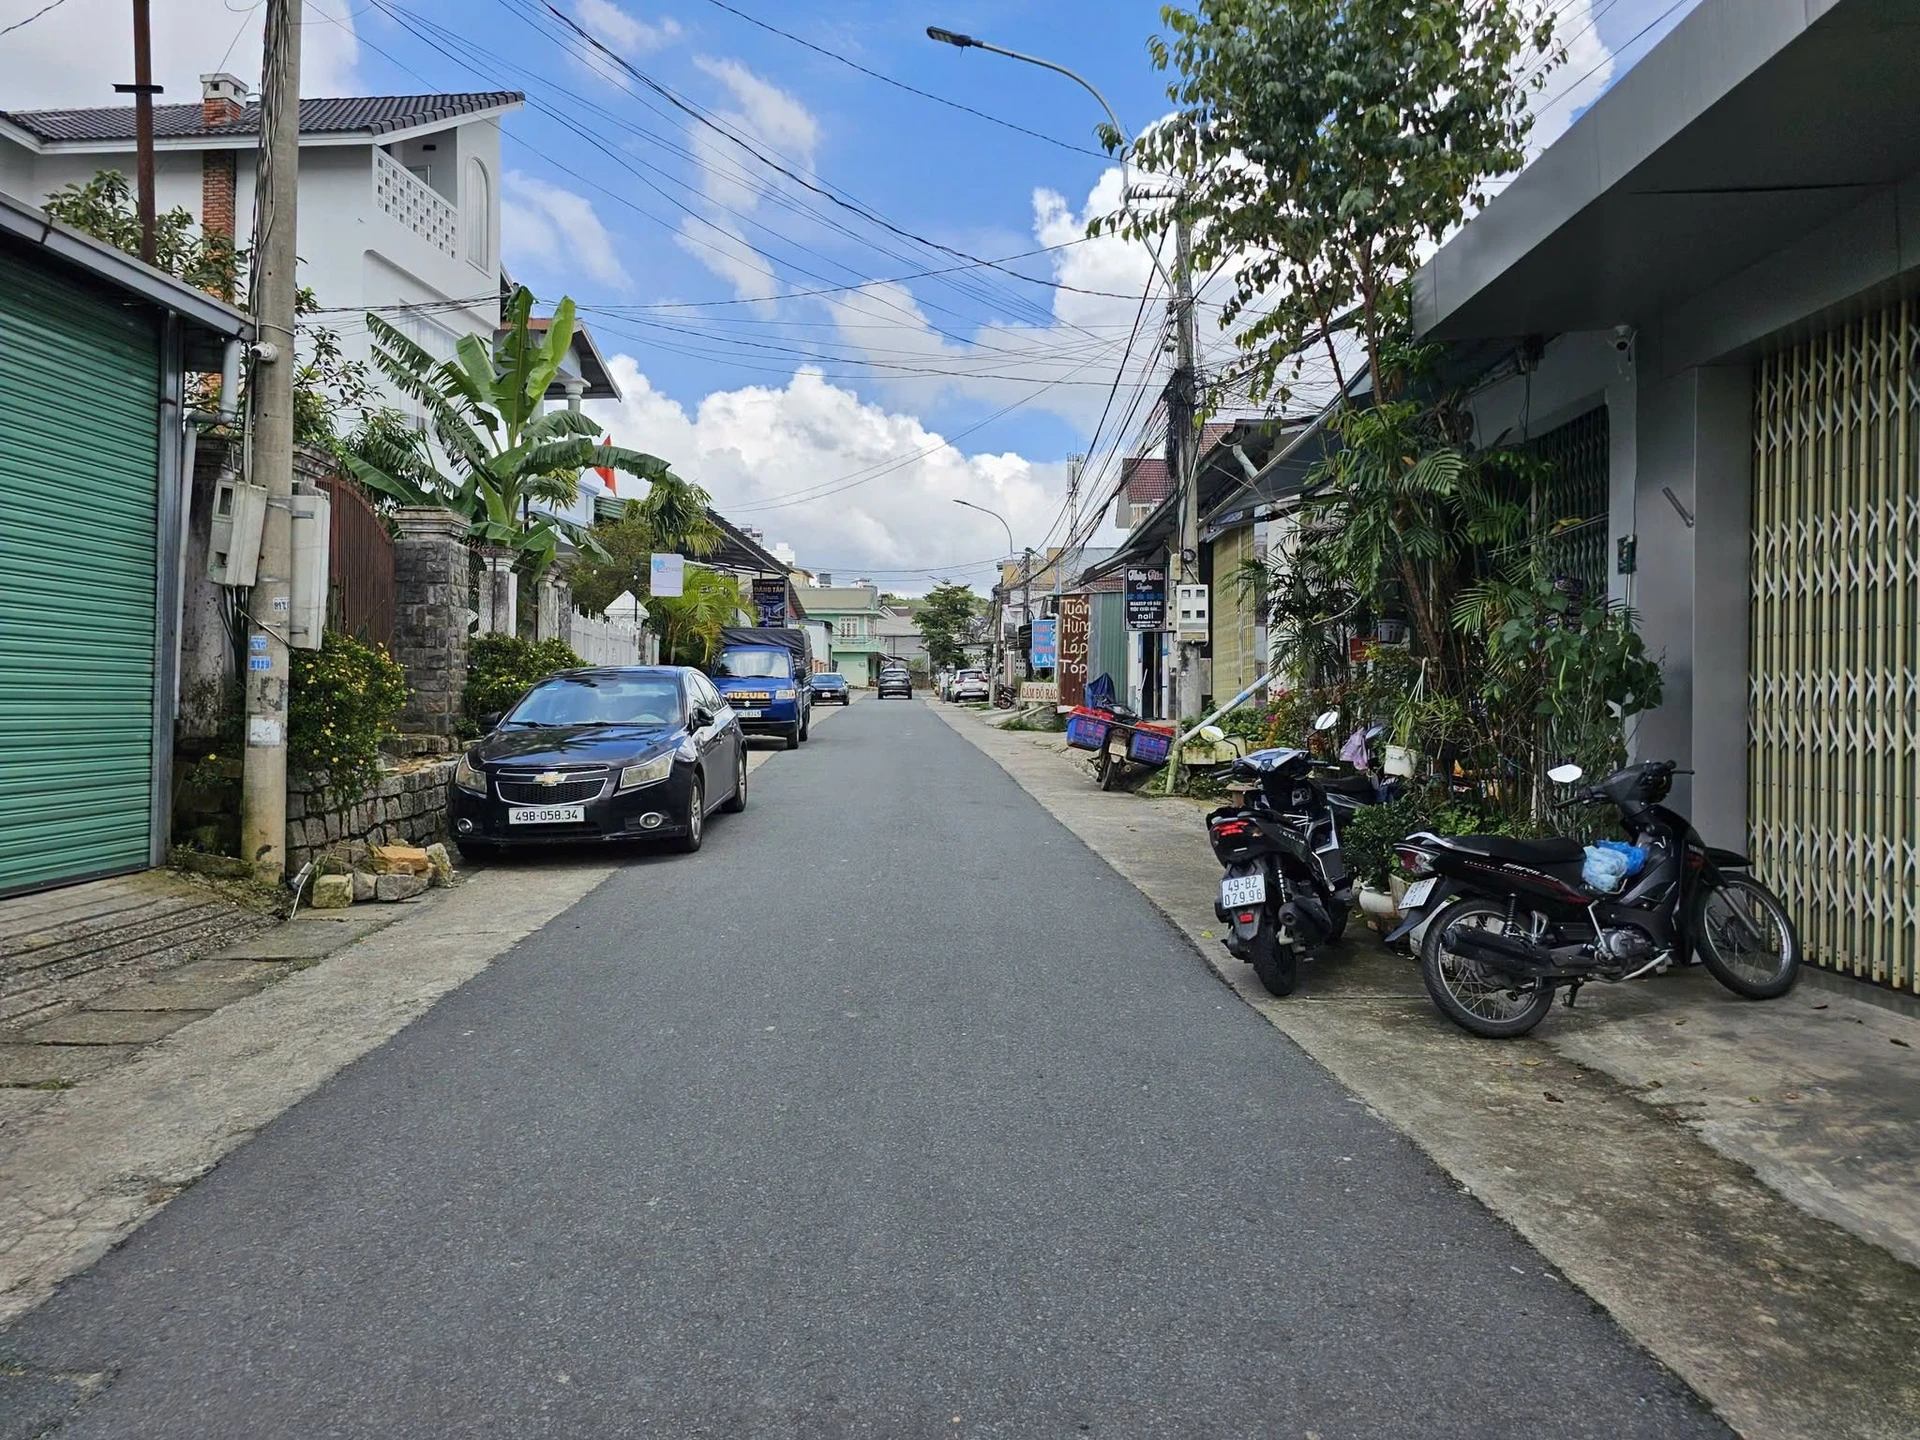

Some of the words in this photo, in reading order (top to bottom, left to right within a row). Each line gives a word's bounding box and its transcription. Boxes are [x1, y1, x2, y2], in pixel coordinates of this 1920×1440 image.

[1060, 594, 1091, 615] Tuấn
[1137, 611, 1154, 620] nail
[1062, 616, 1093, 640] Hùng
[1063, 636, 1088, 660] Láp
[1059, 657, 1088, 681] Tóp
[515, 809, 578, 821] 49B-058.34
[1228, 876, 1257, 892] 49-B2
[1224, 889, 1263, 906] 029.96
